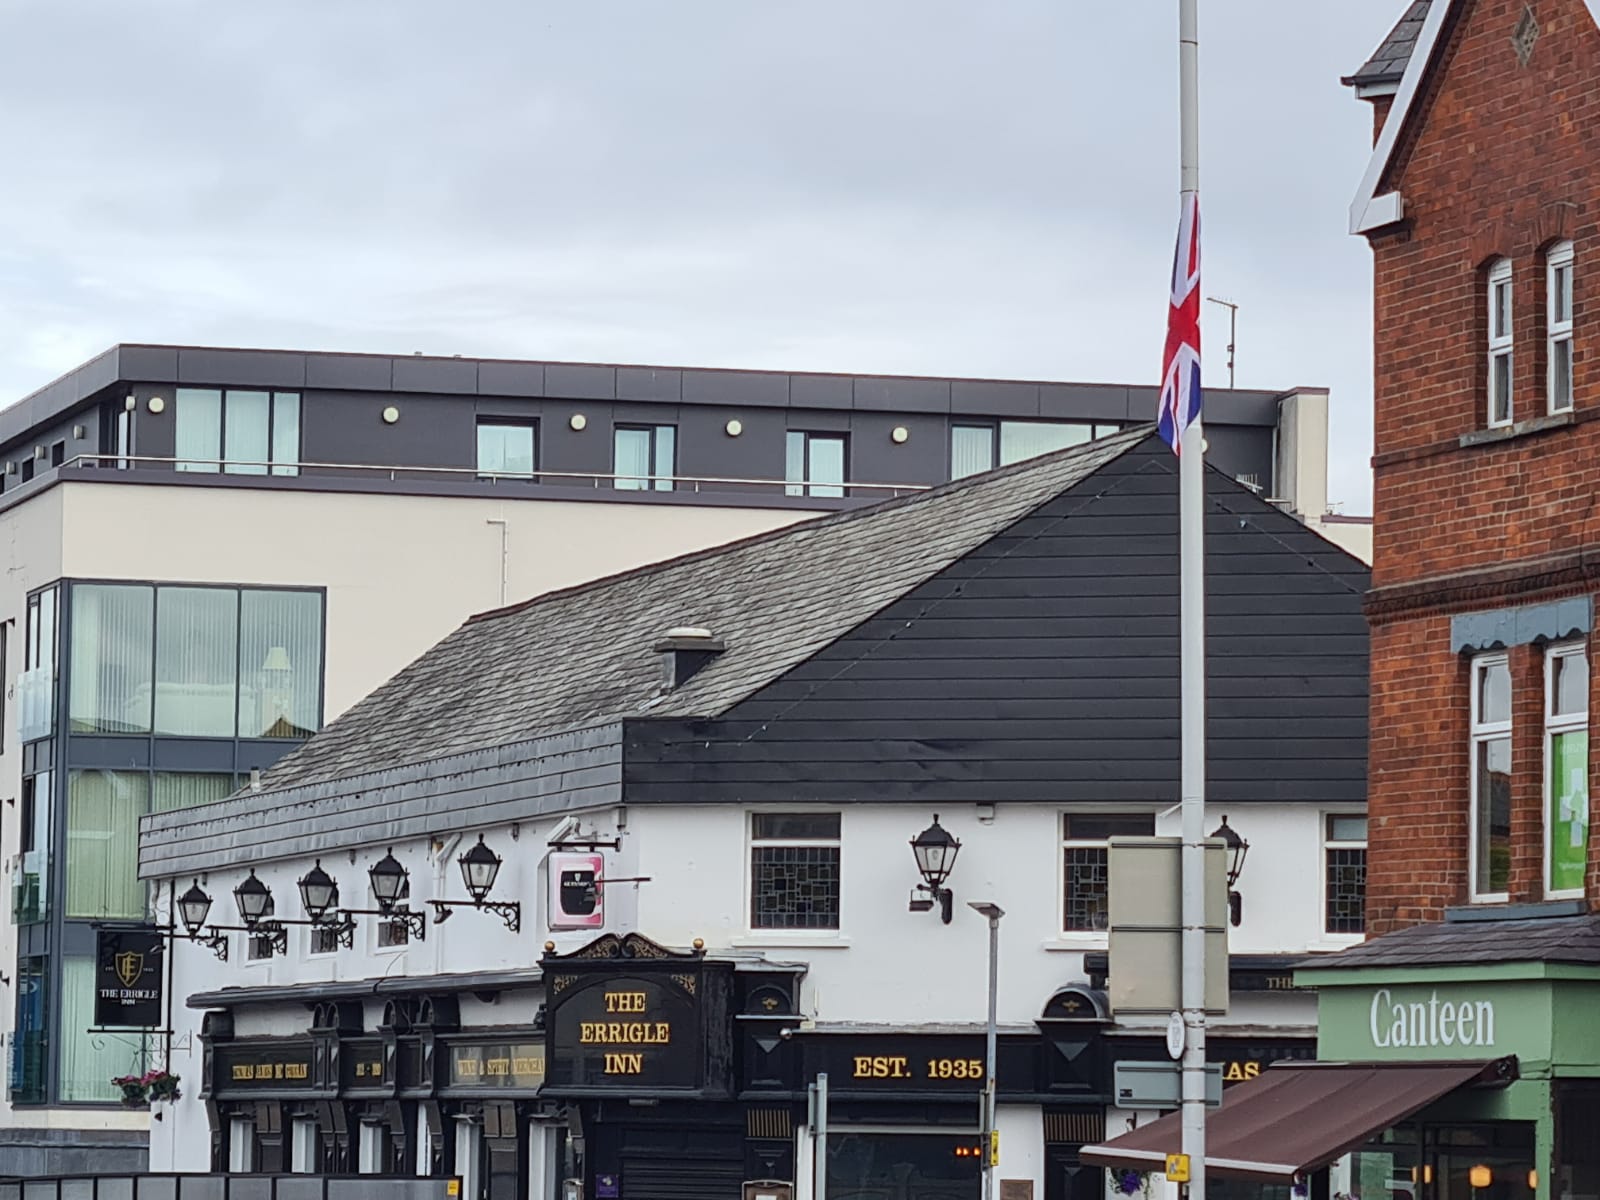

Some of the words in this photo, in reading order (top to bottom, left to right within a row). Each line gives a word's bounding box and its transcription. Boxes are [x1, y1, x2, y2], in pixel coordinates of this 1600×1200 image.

[100, 989, 118, 998] THE
[120, 989, 158, 999] ERRIGLE
[604, 992, 646, 1013] THE
[1370, 988, 1495, 1047] Canteen
[580, 1022, 670, 1043] ERRIGLE
[604, 1053, 643, 1074] INN
[853, 1056, 912, 1078] EST.
[927, 1059, 983, 1079] 1935
[1222, 1061, 1260, 1080] AS
